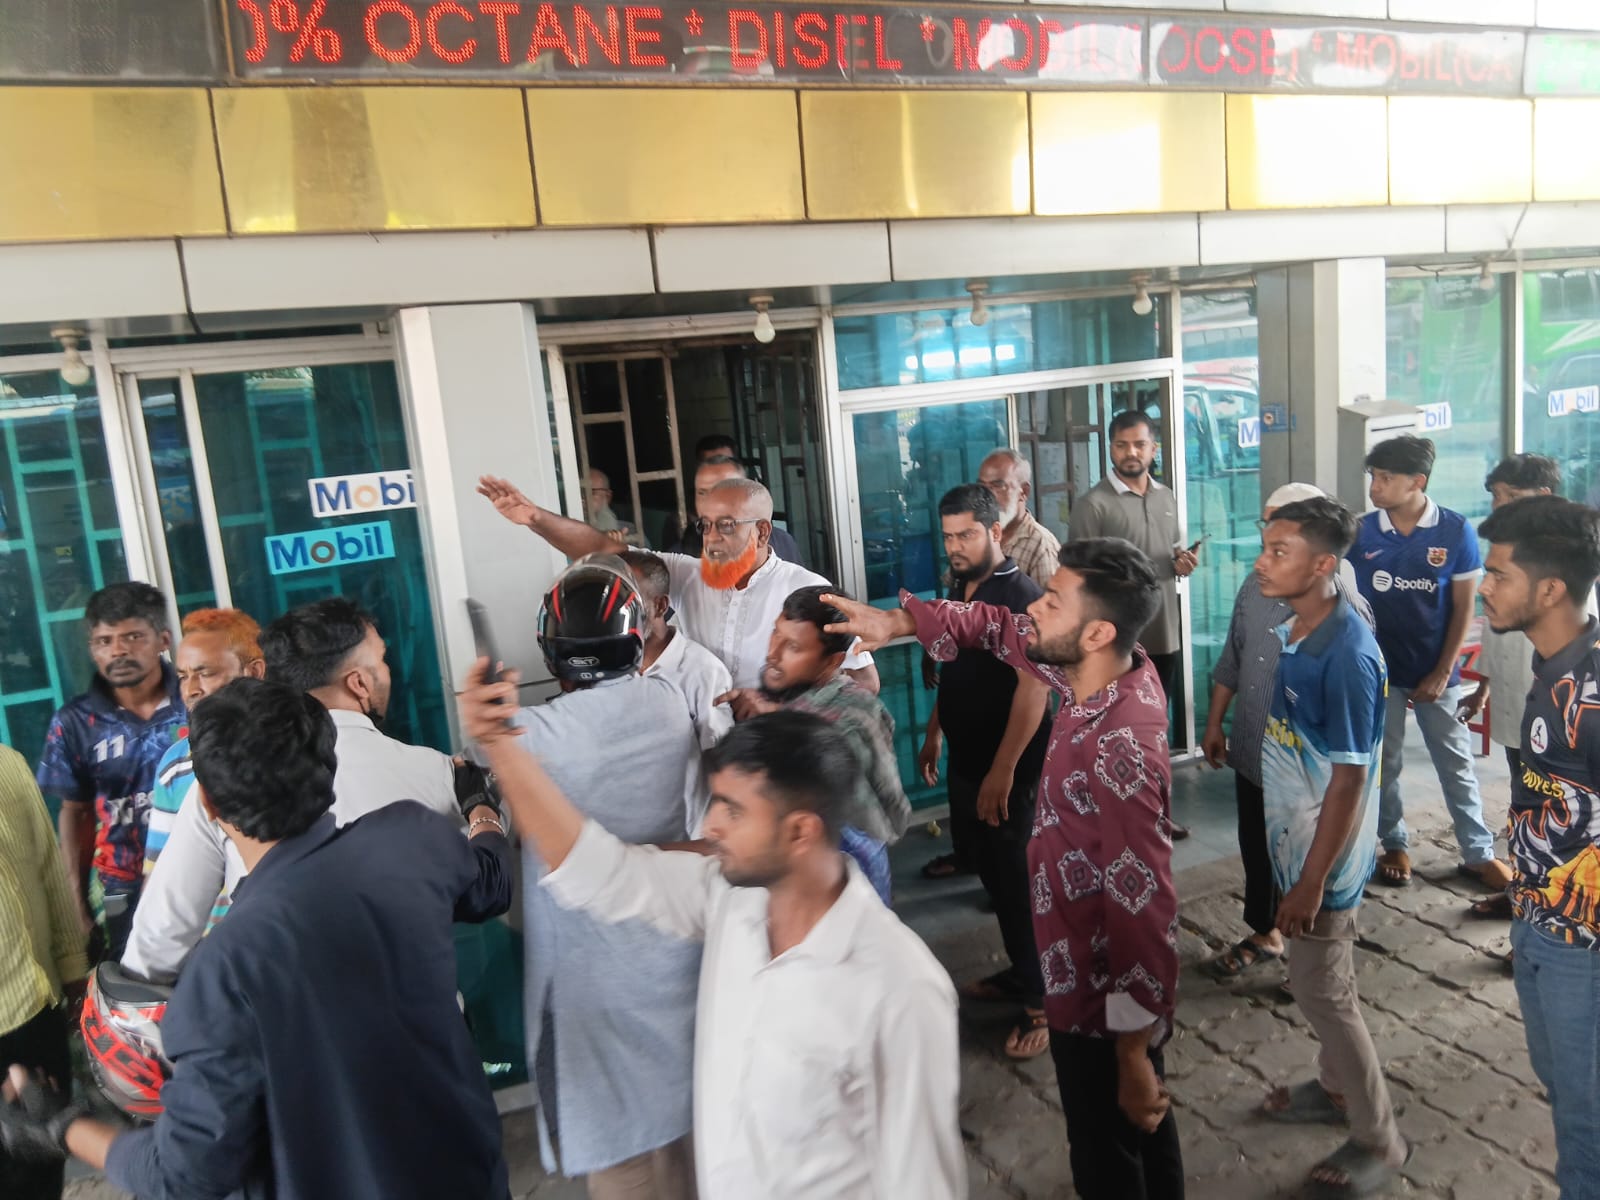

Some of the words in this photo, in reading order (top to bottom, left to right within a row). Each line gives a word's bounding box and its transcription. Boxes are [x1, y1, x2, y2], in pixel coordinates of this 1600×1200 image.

[363, 0, 668, 67] OCTANE
[728, 9, 903, 71] DISEL
[270, 526, 385, 570] Mobil
[1394, 576, 1437, 594] Spotify
[93, 734, 125, 763] 11
